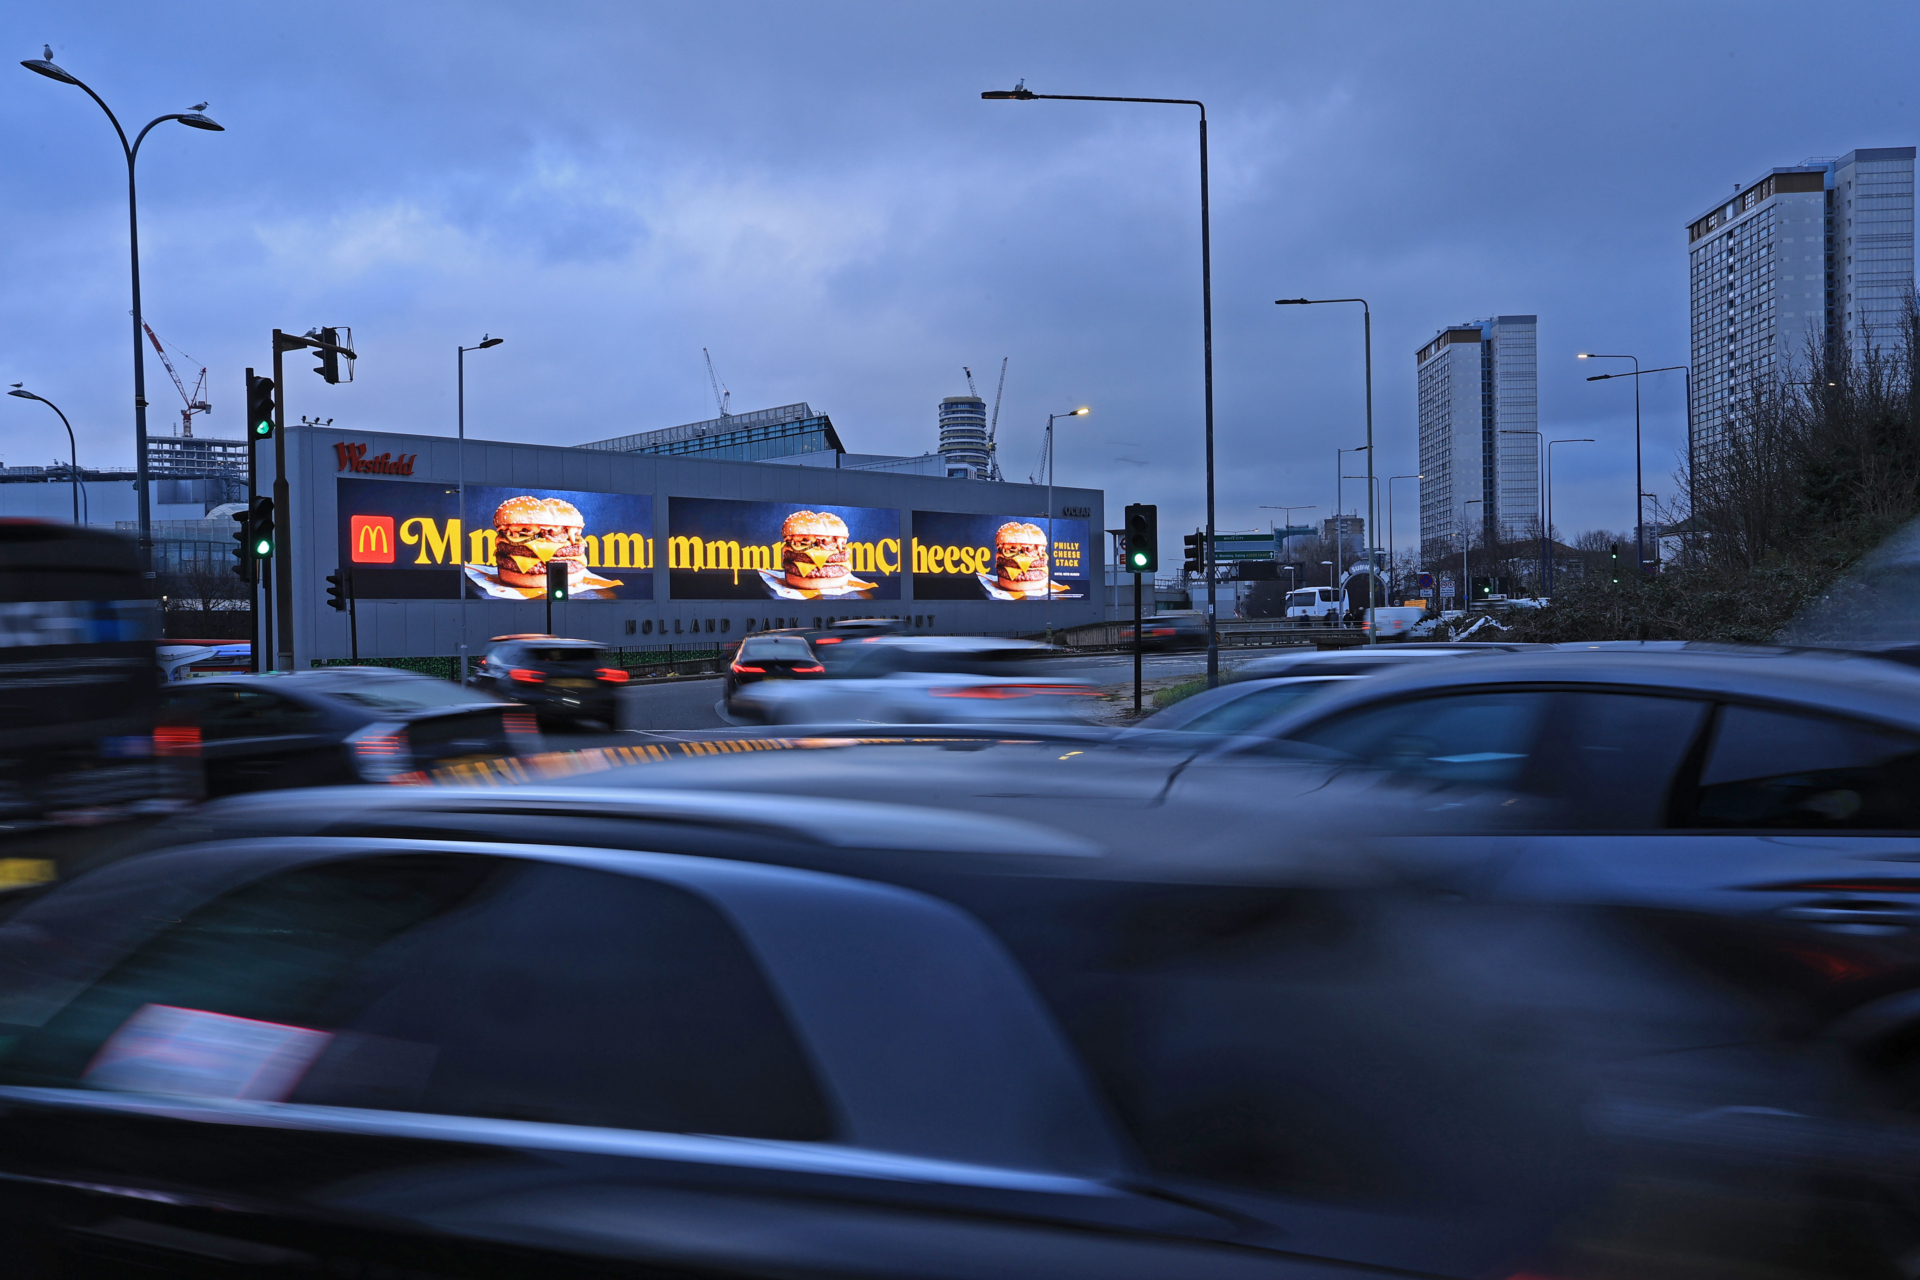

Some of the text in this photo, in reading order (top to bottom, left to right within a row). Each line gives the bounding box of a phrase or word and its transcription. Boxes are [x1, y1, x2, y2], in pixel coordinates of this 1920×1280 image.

[333, 441, 418, 475] Westfield
[1063, 506, 1091, 517] OCEAN
[1054, 542, 1079, 550] PHILLY
[1055, 559, 1079, 567] STACK
[1351, 564, 1378, 572] SUBWY
[625, 618, 731, 635] HOLLAND
[747, 617, 799, 632] PARK
